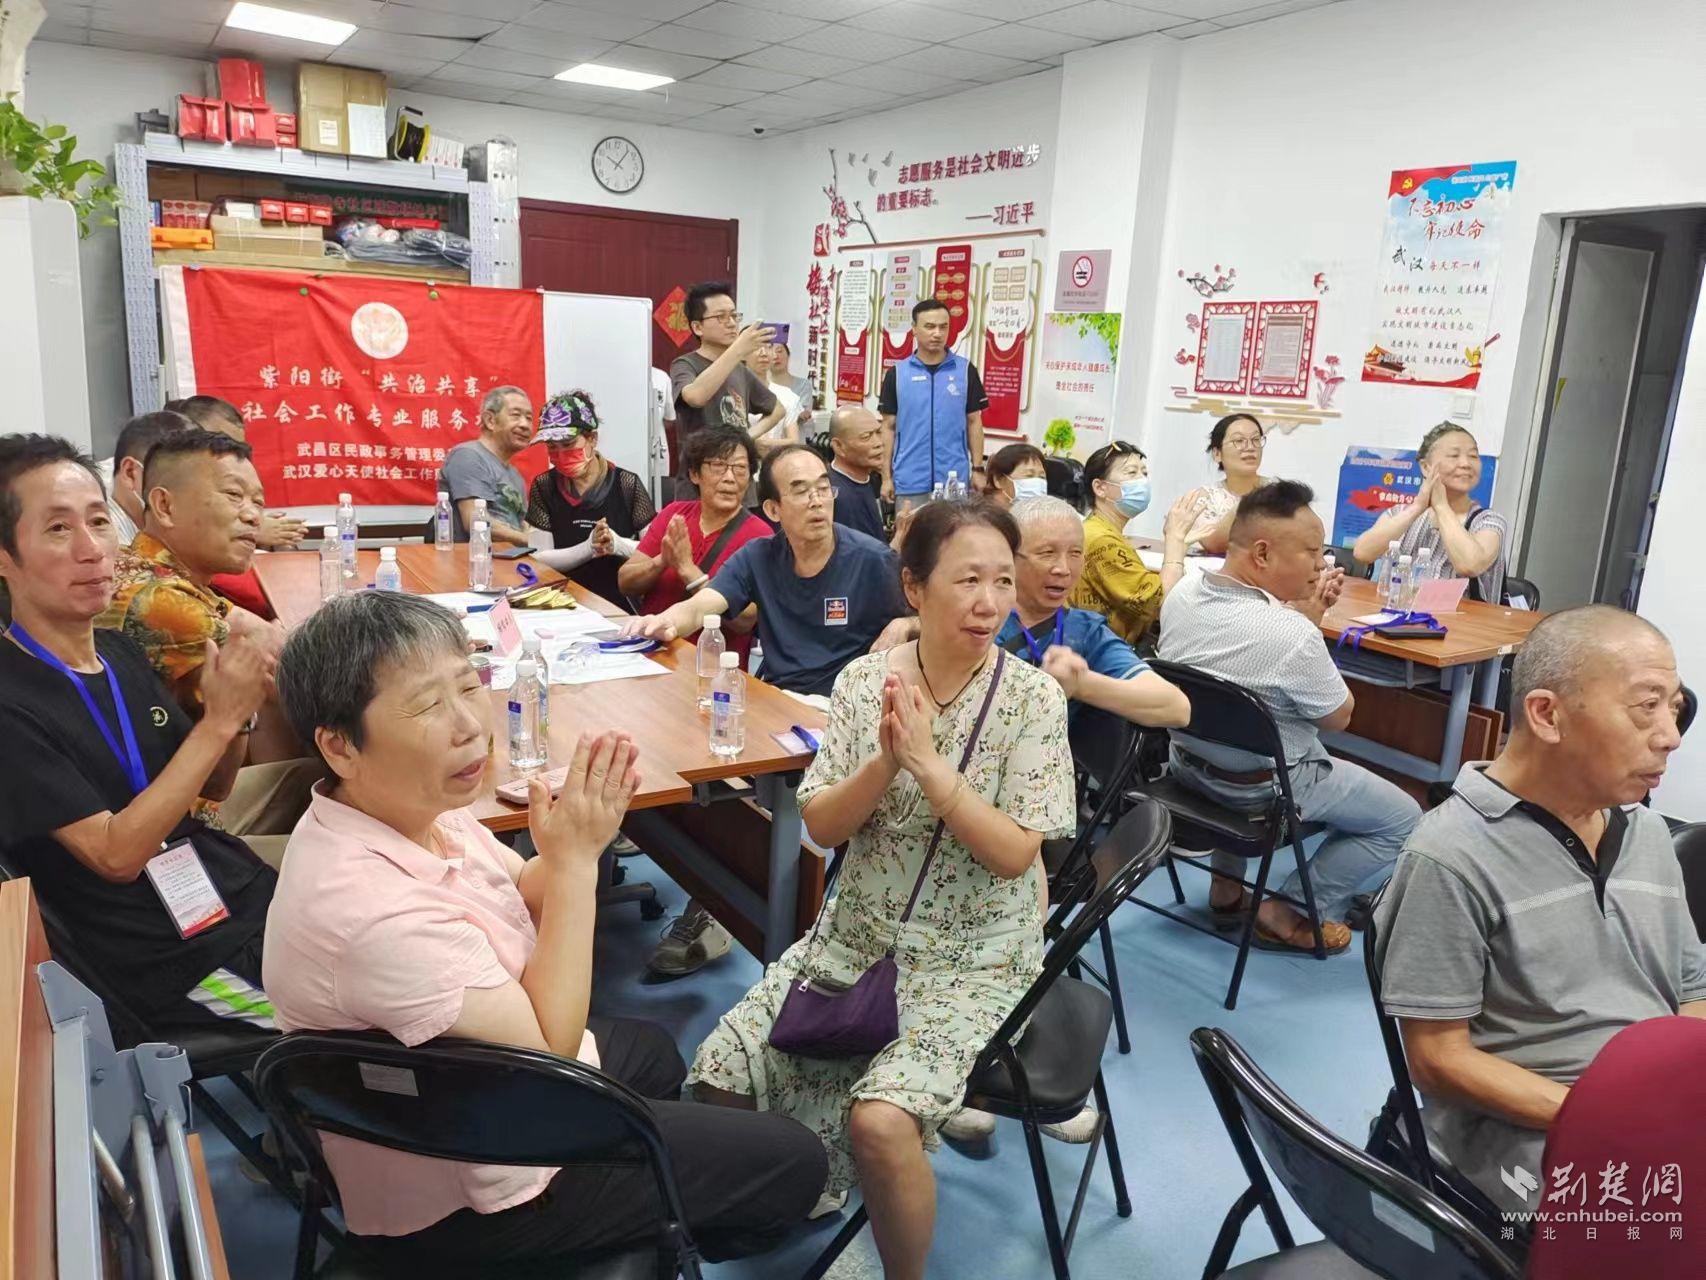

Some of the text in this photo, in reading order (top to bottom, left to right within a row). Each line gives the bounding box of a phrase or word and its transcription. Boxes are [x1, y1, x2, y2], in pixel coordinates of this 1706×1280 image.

[897, 143, 1041, 184] 志愿服务是社会文明进步
[241, 400, 481, 431] 社会工作专业服务
[296, 441, 451, 463] 武昌区民政事务管理委
